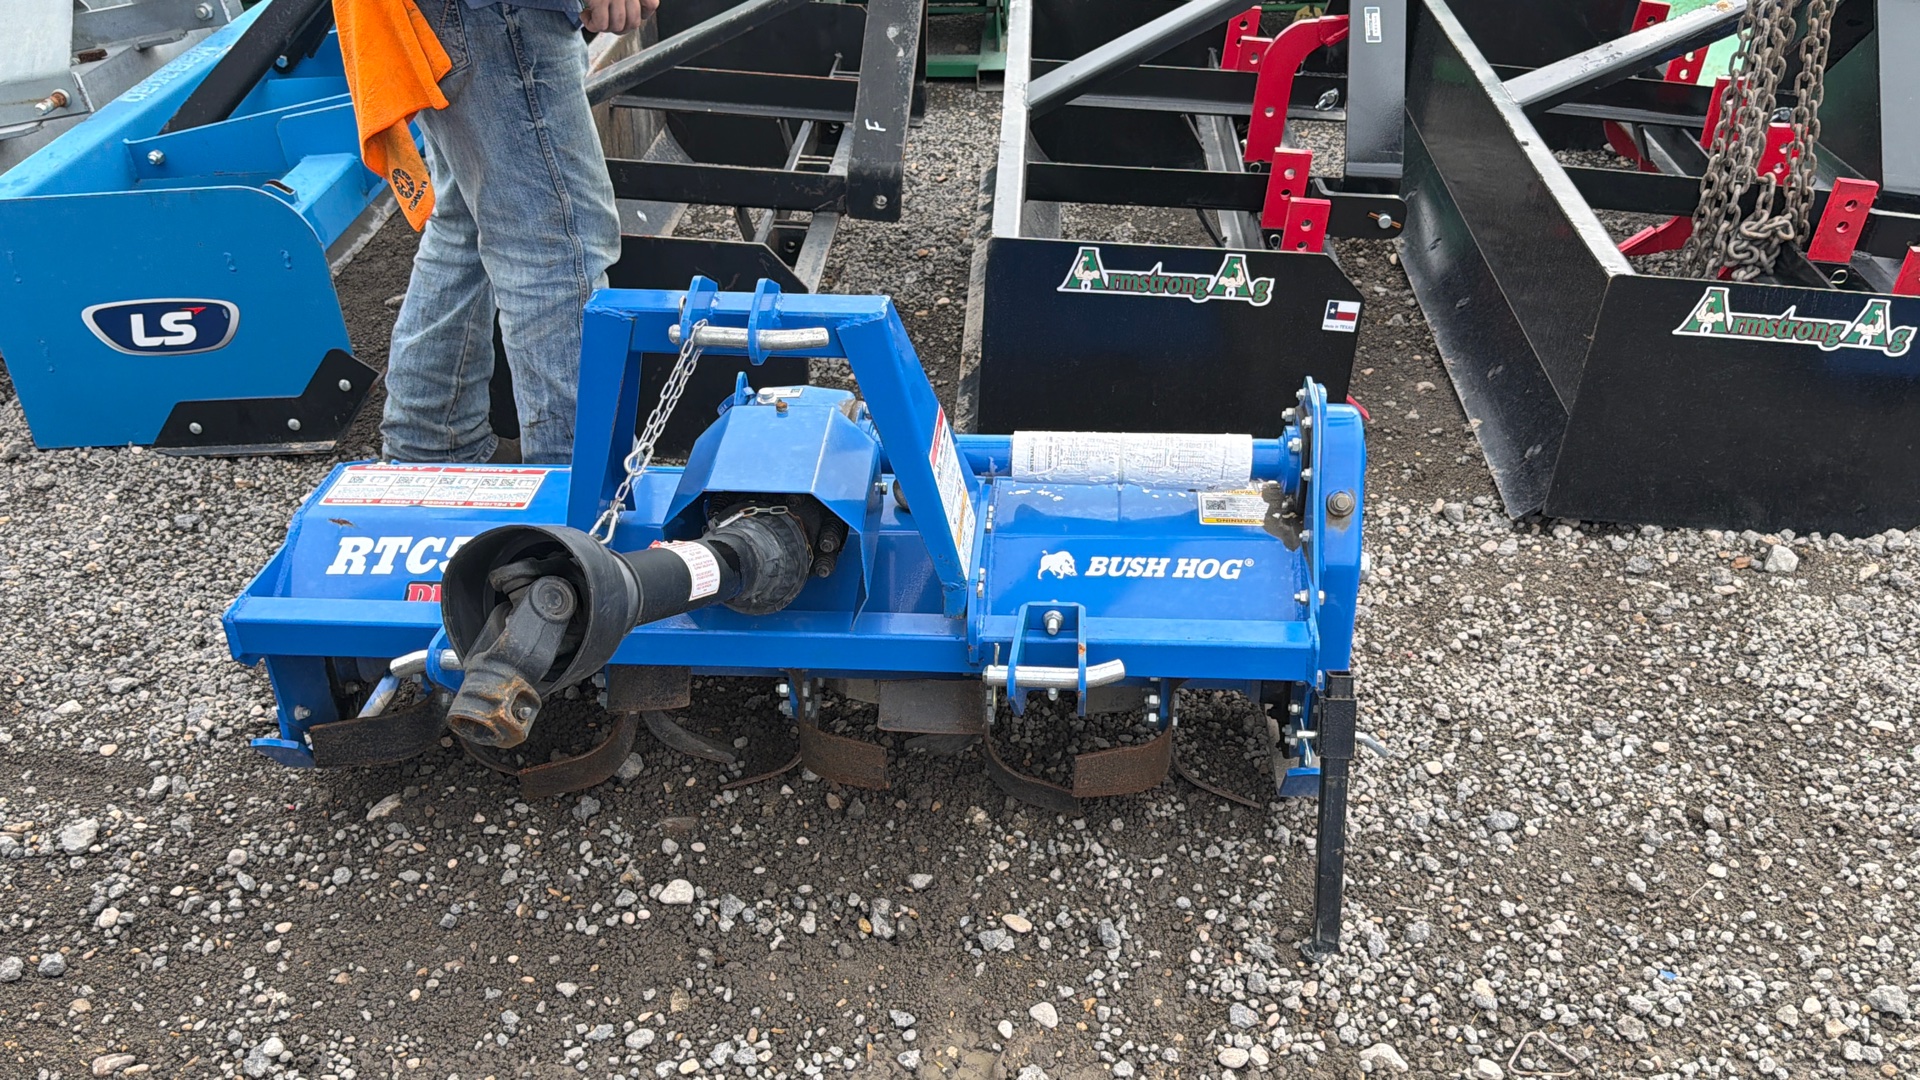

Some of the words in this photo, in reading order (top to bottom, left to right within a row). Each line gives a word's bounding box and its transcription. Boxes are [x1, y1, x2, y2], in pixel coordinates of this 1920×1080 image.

[1062, 249, 1210, 298] Armstrong
[1209, 255, 1271, 302] Ag
[130, 310, 198, 347] LS
[1680, 289, 1845, 347] Armstrong
[1841, 301, 1911, 353] Ag
[1085, 556, 1171, 578] BUSH
